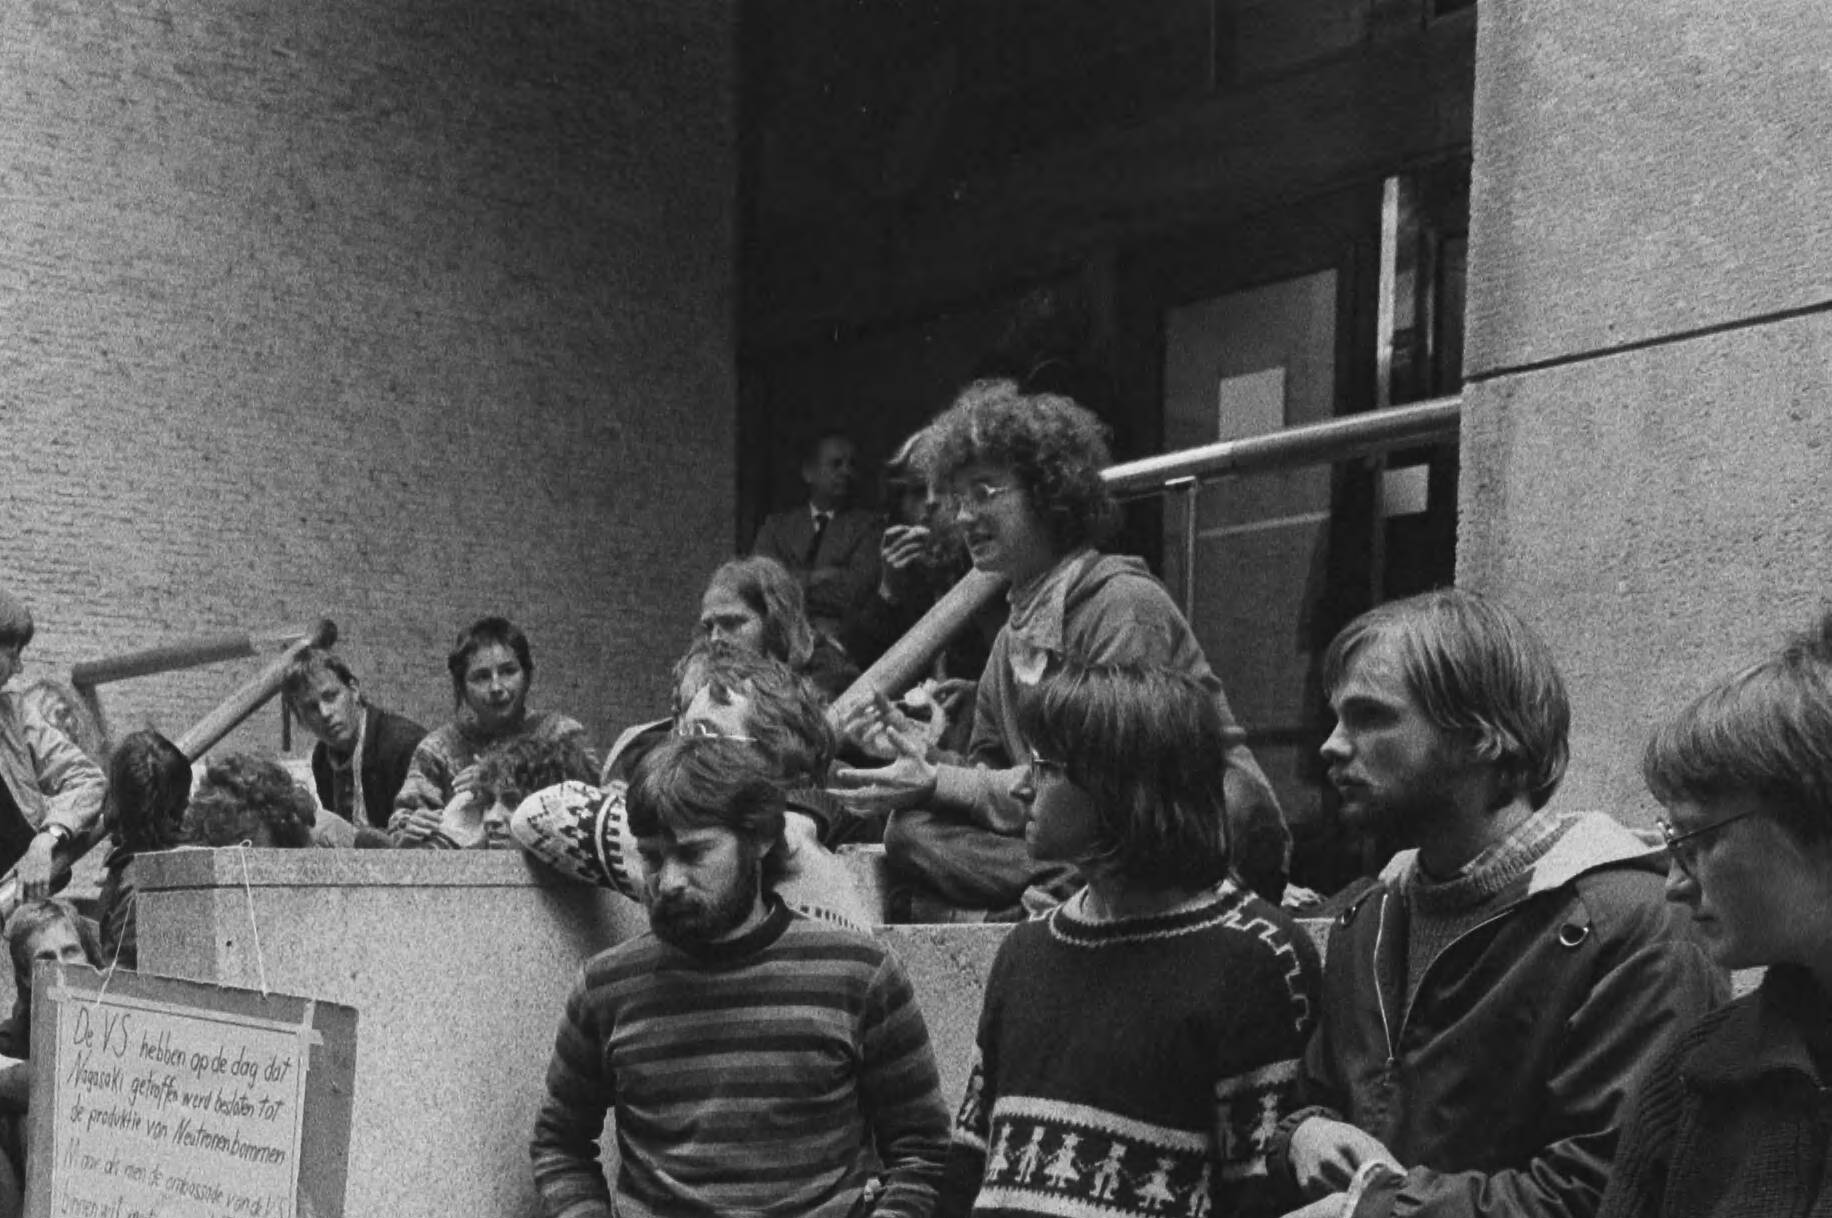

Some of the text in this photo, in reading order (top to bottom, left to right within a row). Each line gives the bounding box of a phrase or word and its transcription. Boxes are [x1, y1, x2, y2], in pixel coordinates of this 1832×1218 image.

[73, 1007, 94, 1048] De
[102, 1009, 132, 1058] VS
[139, 1029, 186, 1066] hebben
[231, 1045, 258, 1090] dag
[264, 1054, 292, 1083] dat
[67, 1050, 124, 1093] Nagasaki
[129, 1070, 178, 1111] getroffen
[182, 1089, 212, 1110] werd
[258, 1096, 286, 1122] tot
[70, 1093, 85, 1123] de
[86, 1105, 141, 1132] produktie
[146, 1119, 168, 1140] van
[166, 1166, 224, 1204] ambassade
